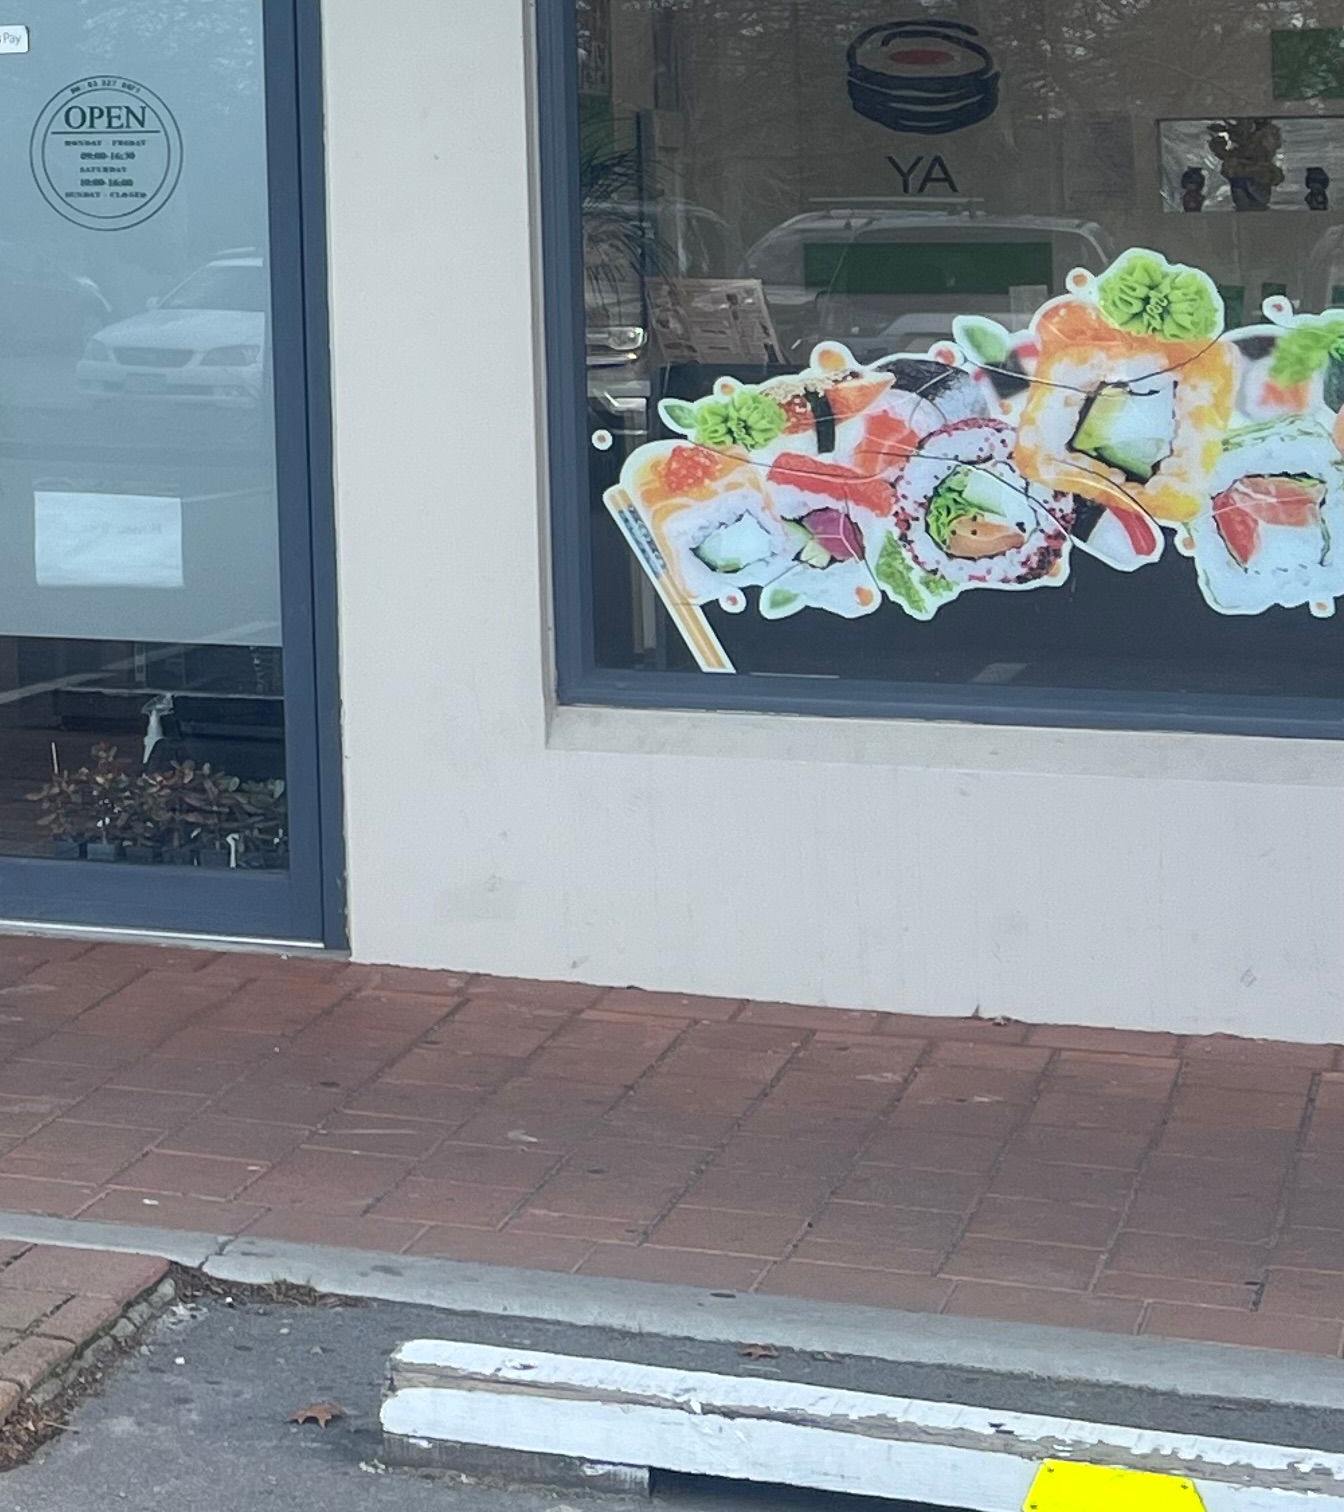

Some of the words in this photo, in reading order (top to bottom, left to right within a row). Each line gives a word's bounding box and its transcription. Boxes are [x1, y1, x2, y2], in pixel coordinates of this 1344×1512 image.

[2, 31, 22, 45] Pay
[64, 105, 147, 130] OPEN
[64, 139, 102, 147] MONDAY
[111, 139, 147, 147] FRIDAY
[885, 154, 960, 195] YA
